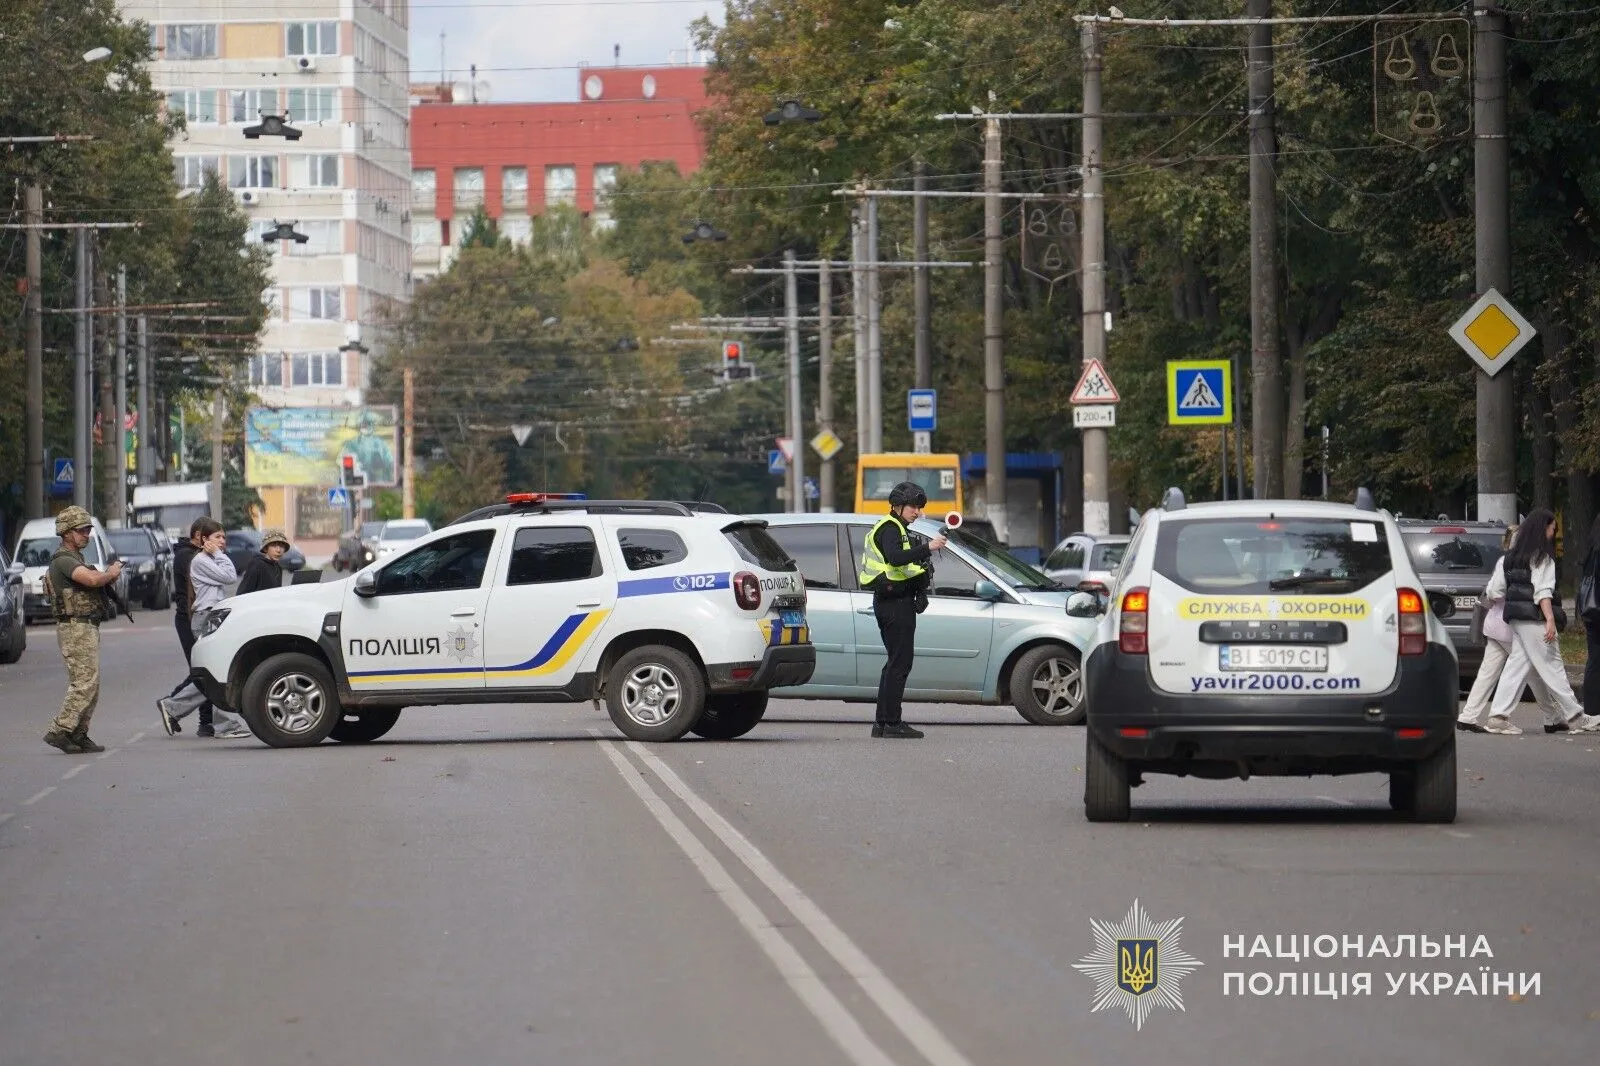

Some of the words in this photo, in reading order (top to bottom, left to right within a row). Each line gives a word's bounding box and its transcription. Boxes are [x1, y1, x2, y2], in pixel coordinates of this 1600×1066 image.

[1083, 411, 1100, 421] 200
[690, 575, 715, 588] 102
[1189, 602, 1262, 614] СЛУЖБА
[1281, 601, 1366, 614] ОХОРОНИ
[1385, 613, 1396, 626] 4
[1231, 631, 1315, 640] DUSTER
[349, 637, 440, 656] ПОЛІЦІЯ
[1231, 648, 1251, 664] BI
[1258, 649, 1295, 664] 5019
[1299, 649, 1319, 665] CI
[1191, 674, 1361, 692] yavir2000.com
